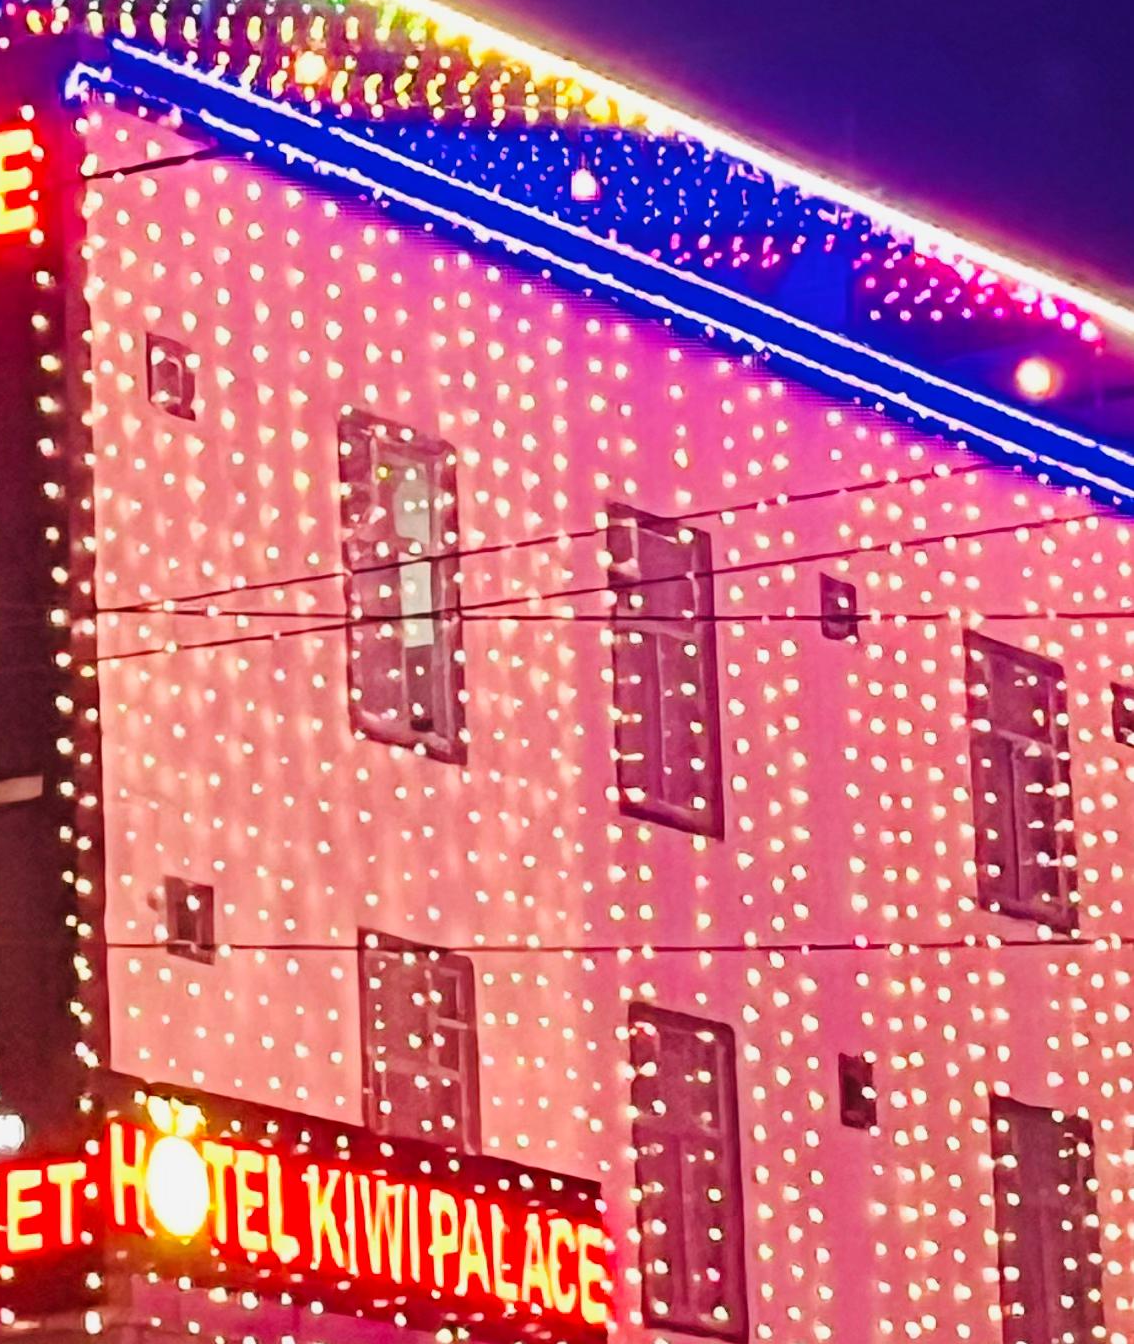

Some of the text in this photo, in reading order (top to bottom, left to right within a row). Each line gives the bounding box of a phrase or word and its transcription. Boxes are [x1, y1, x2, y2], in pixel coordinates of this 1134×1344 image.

[108, 1120, 300, 1264] HOTEL
[302, 1163, 421, 1284] KIWI
[428, 1188, 609, 1326] PALACE
